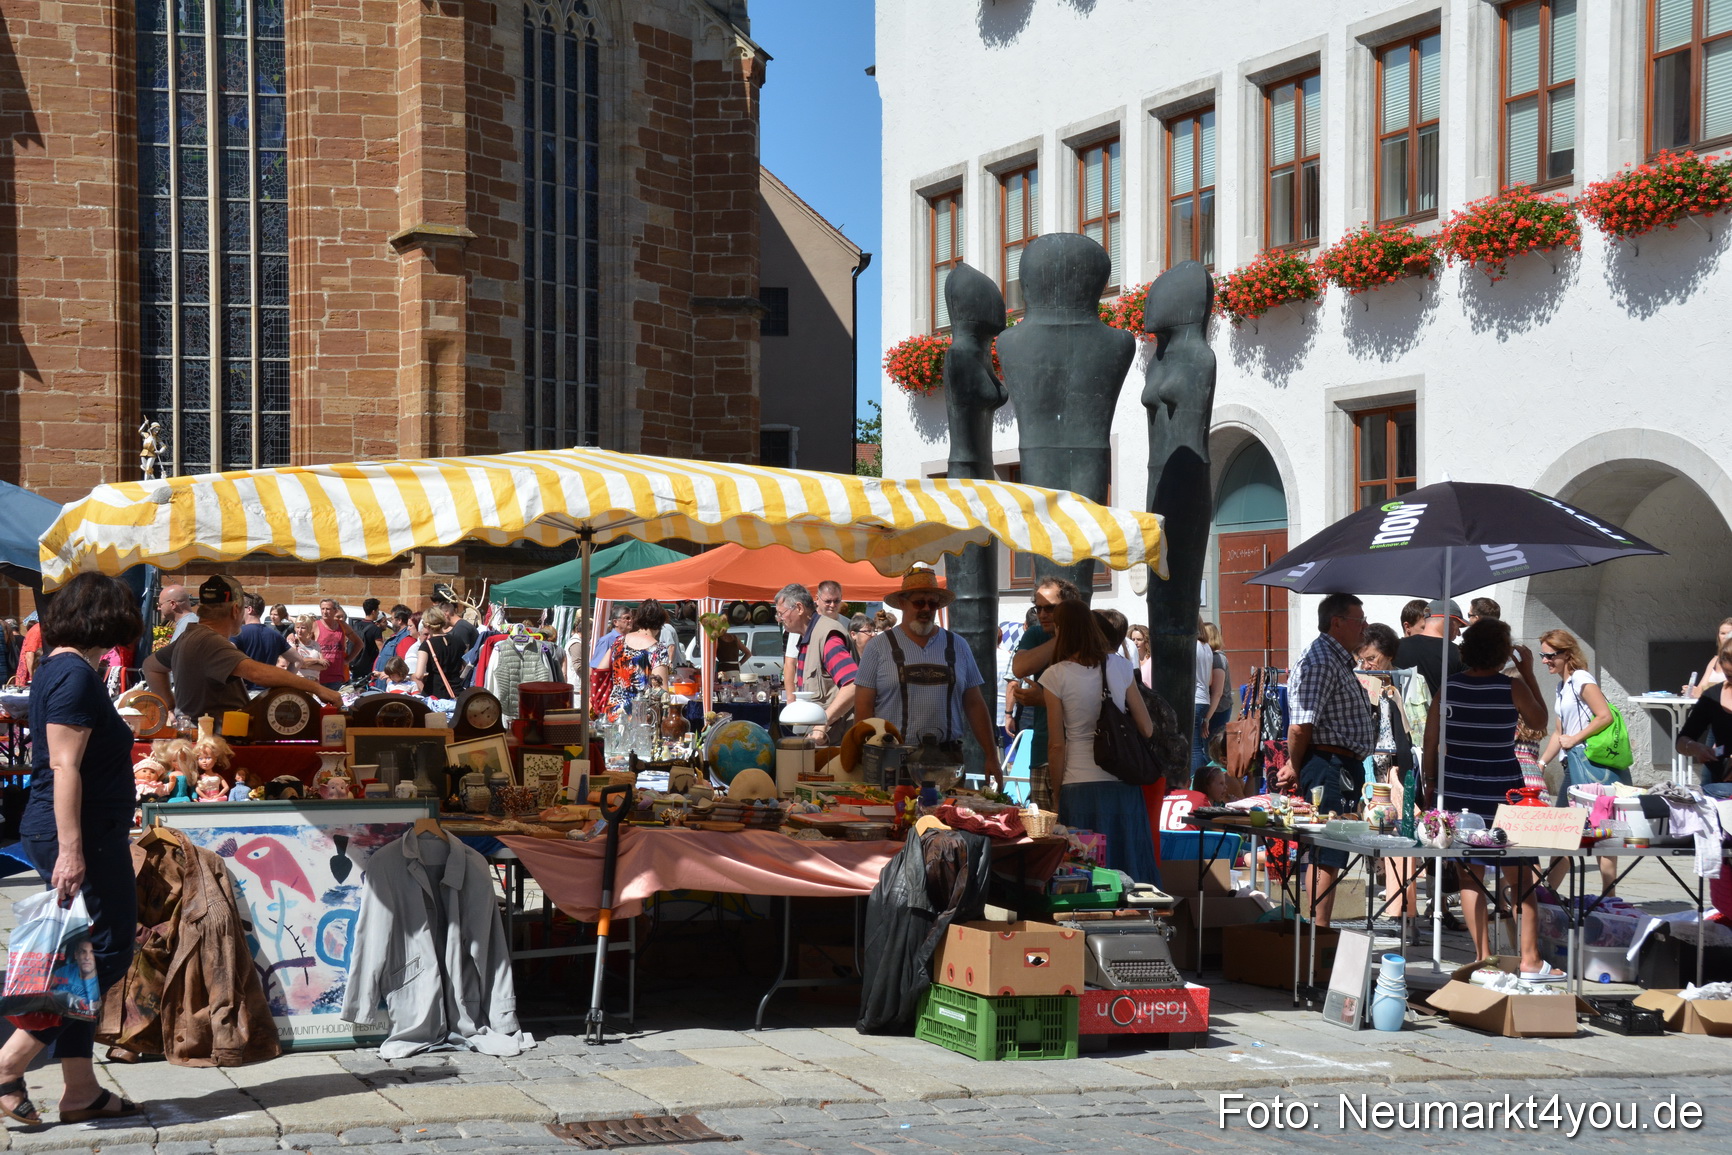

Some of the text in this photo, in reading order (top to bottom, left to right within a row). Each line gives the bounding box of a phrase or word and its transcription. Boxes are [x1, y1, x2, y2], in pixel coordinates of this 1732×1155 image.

[1372, 503, 1428, 545] now
[1159, 800, 1193, 831] 18
[277, 1021, 388, 1037] OMMUNITY HOLIDAY FESTIVAL
